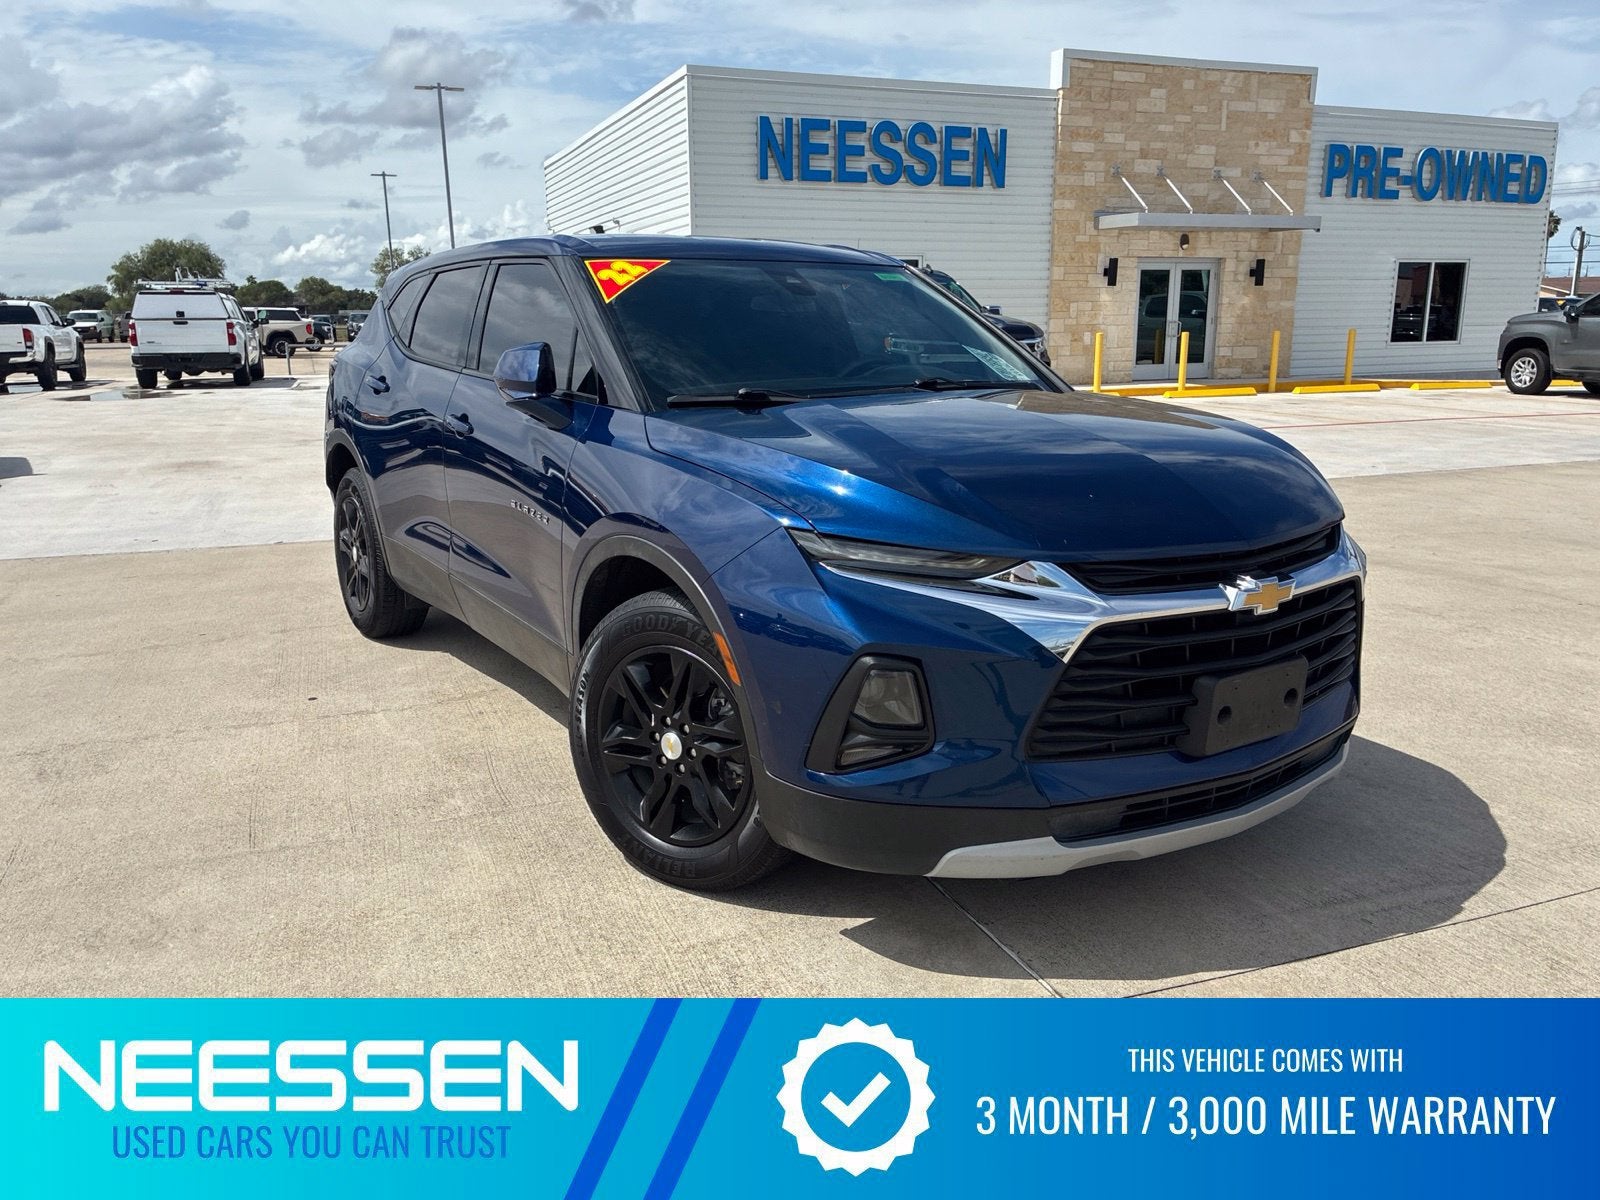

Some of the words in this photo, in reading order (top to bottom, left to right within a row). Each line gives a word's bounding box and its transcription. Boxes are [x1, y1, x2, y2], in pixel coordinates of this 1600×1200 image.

[757, 115, 1008, 189] NEESSEN
[1321, 143, 1548, 205] PRE-OWNED
[597, 260, 649, 286] 22
[510, 499, 550, 526] BLAZER
